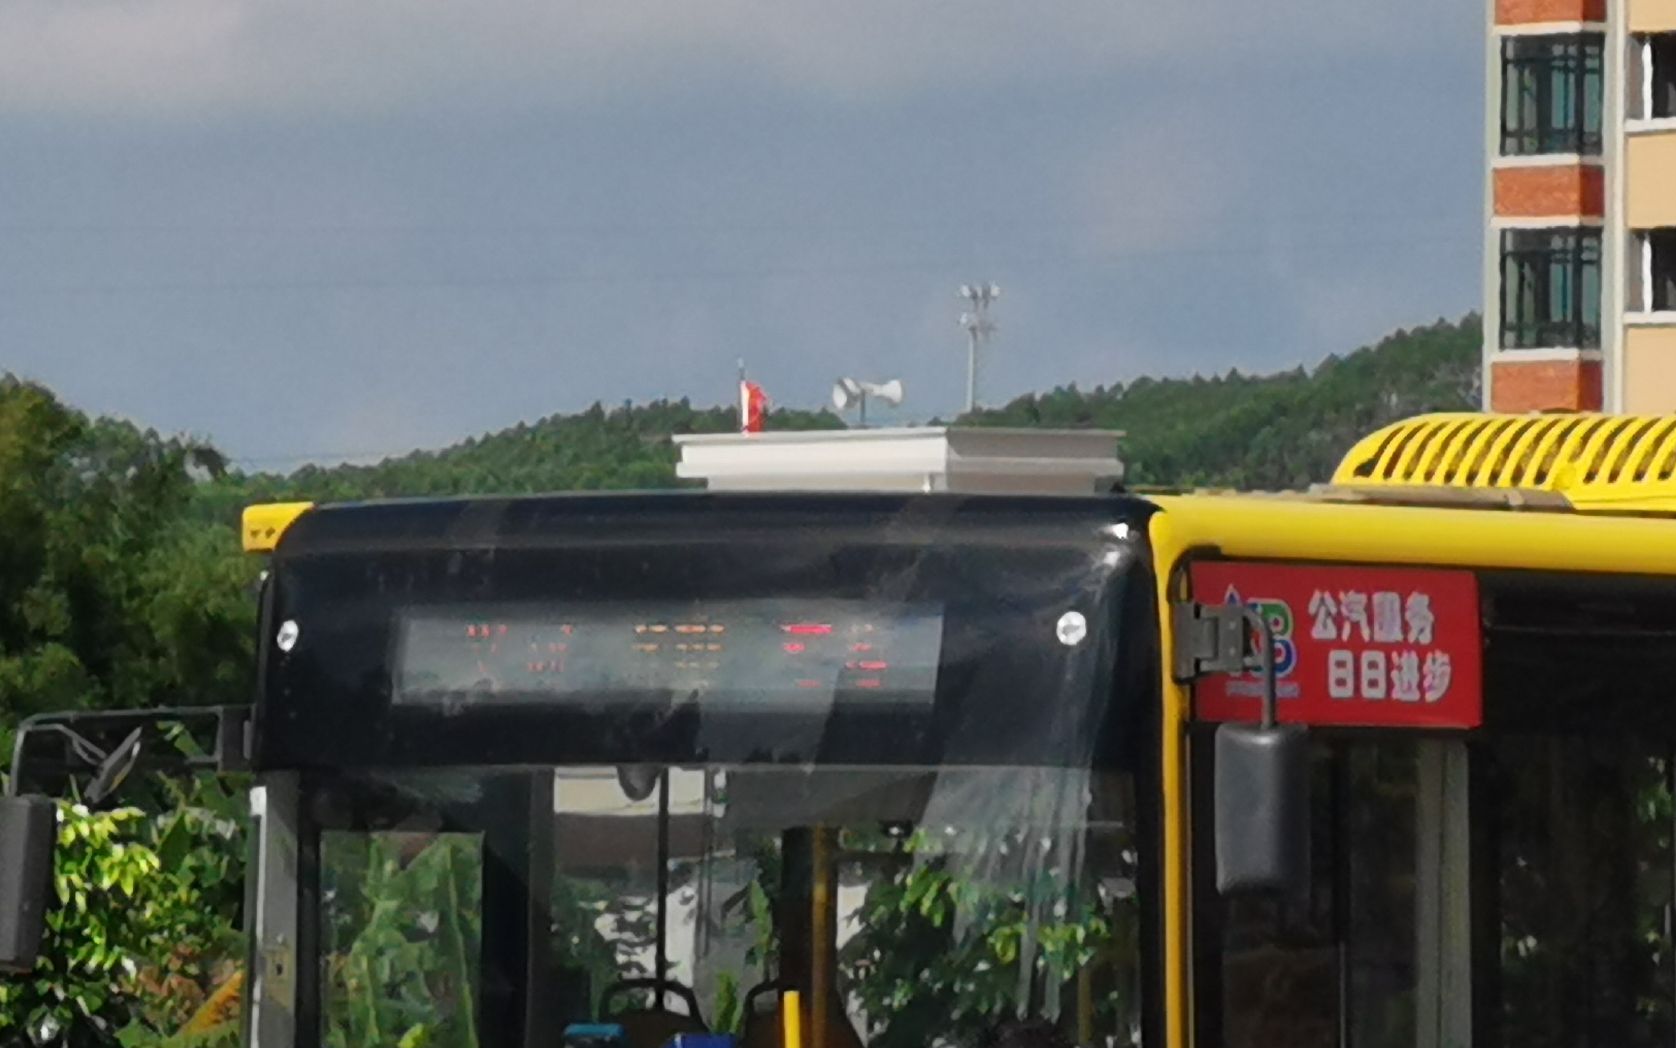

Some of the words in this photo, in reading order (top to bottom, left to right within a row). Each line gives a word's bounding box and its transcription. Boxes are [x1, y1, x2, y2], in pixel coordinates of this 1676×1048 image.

[1309, 588, 1434, 645] 公汽服务
[1327, 649, 1452, 702] 日日进步
